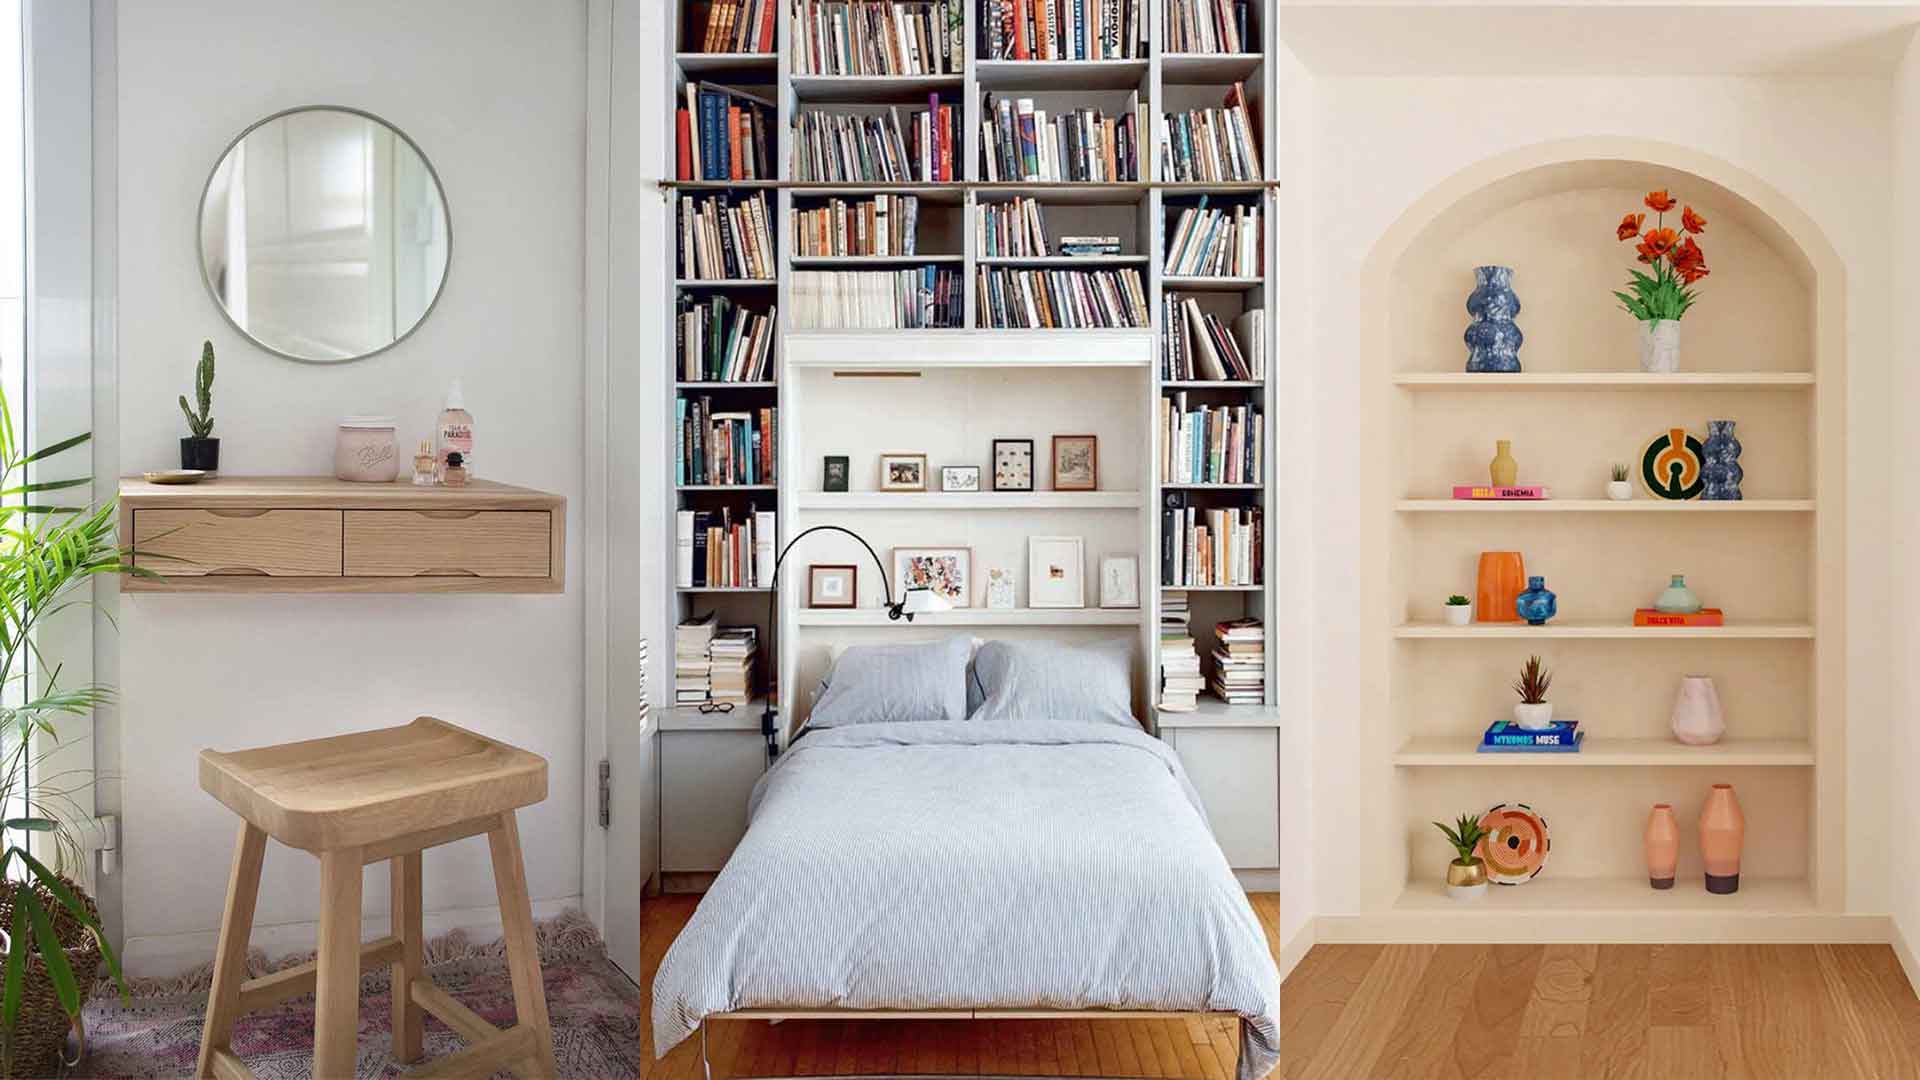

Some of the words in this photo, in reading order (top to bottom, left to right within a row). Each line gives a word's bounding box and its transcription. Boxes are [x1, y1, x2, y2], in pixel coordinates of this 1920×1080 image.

[1502, 489, 1534, 497] BOHEMIA
[1494, 735, 1534, 745] MYKONOS
[1536, 735, 1560, 745] MUSE
